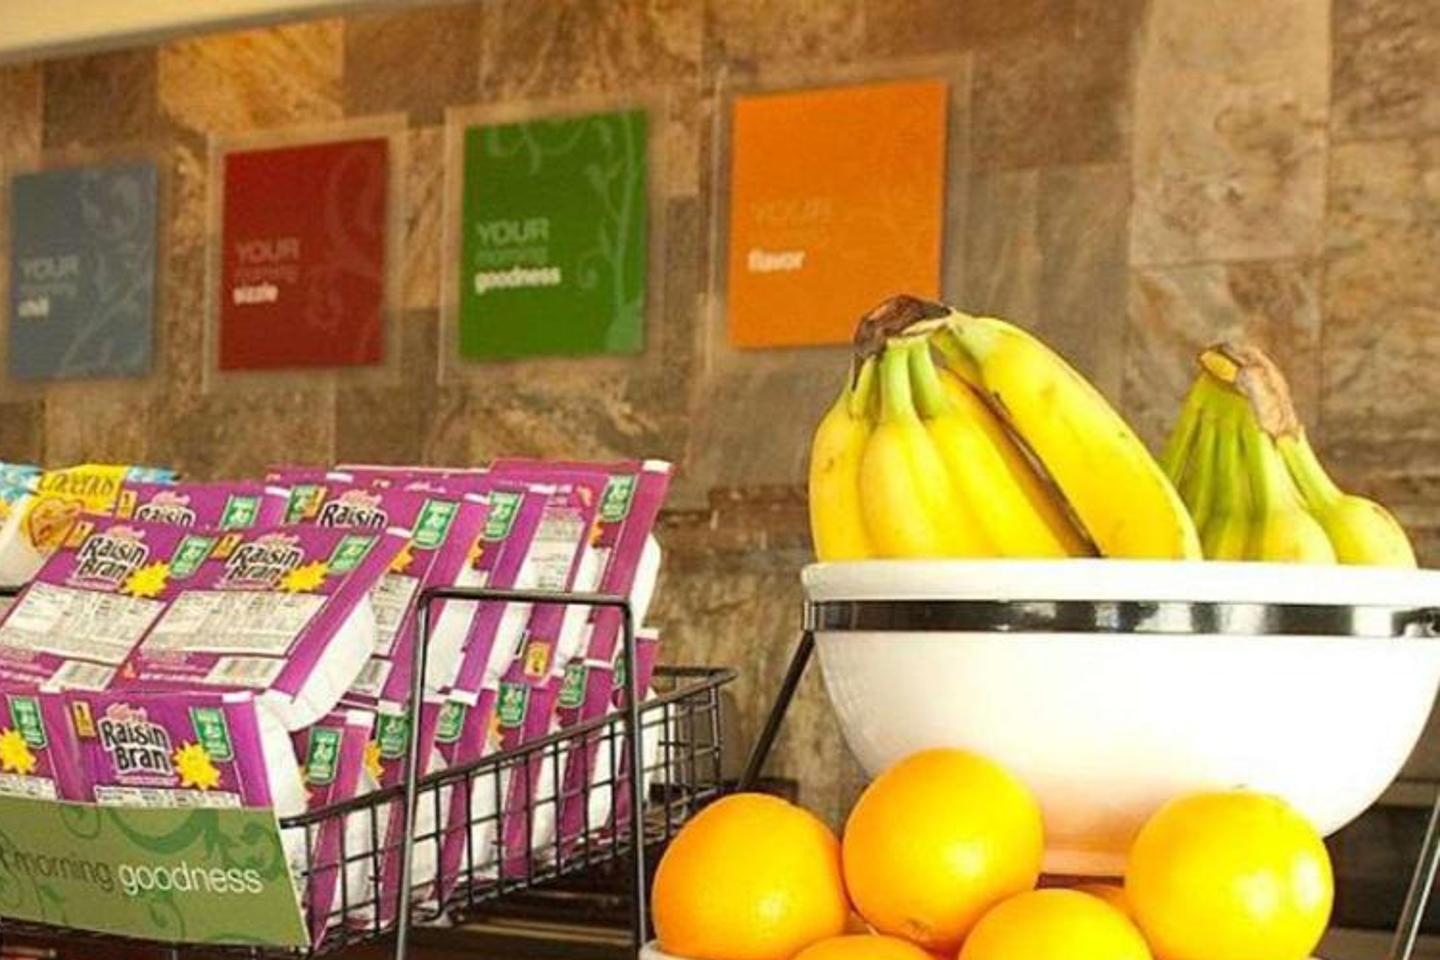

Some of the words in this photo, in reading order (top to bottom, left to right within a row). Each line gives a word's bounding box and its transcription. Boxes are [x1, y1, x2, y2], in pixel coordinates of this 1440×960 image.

[476, 217, 549, 246] YOUR
[235, 235, 300, 264] YOUR
[20, 253, 79, 278] YOUR
[474, 265, 561, 296] goodness
[83, 536, 146, 566] Raisin
[229, 545, 301, 568] Raisin
[79, 558, 126, 582] Bran
[101, 721, 168, 752] Raisin
[114, 747, 169, 772] Bran
[13, 848, 115, 892] morning
[119, 861, 264, 895] goodness
